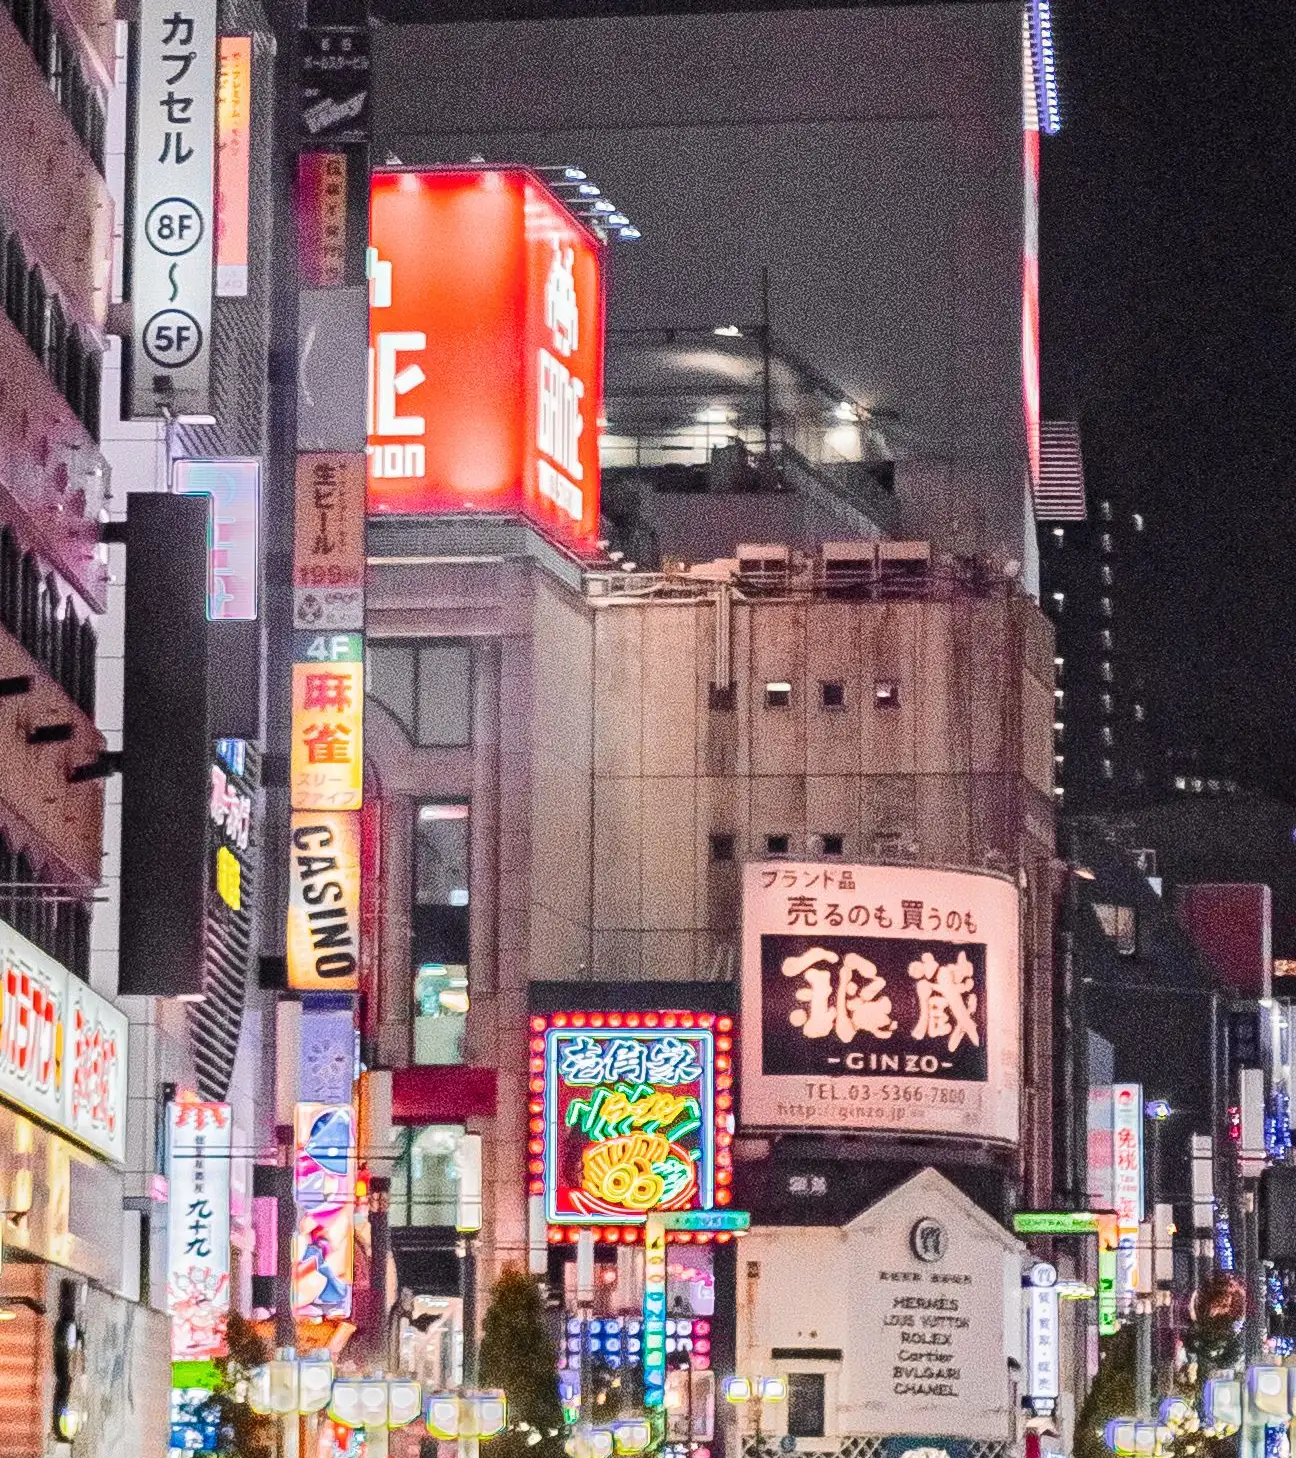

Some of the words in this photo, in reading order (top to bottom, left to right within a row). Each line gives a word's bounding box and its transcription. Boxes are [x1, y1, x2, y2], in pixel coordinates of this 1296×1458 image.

[157, 12, 196, 166] カプセル
[305, 635, 350, 661] 4F
[302, 671, 353, 765] 麻雀
[292, 824, 356, 980] CASINO
[781, 946, 980, 1053] 銀蔵
[185, 1198, 214, 1258] 九十九
